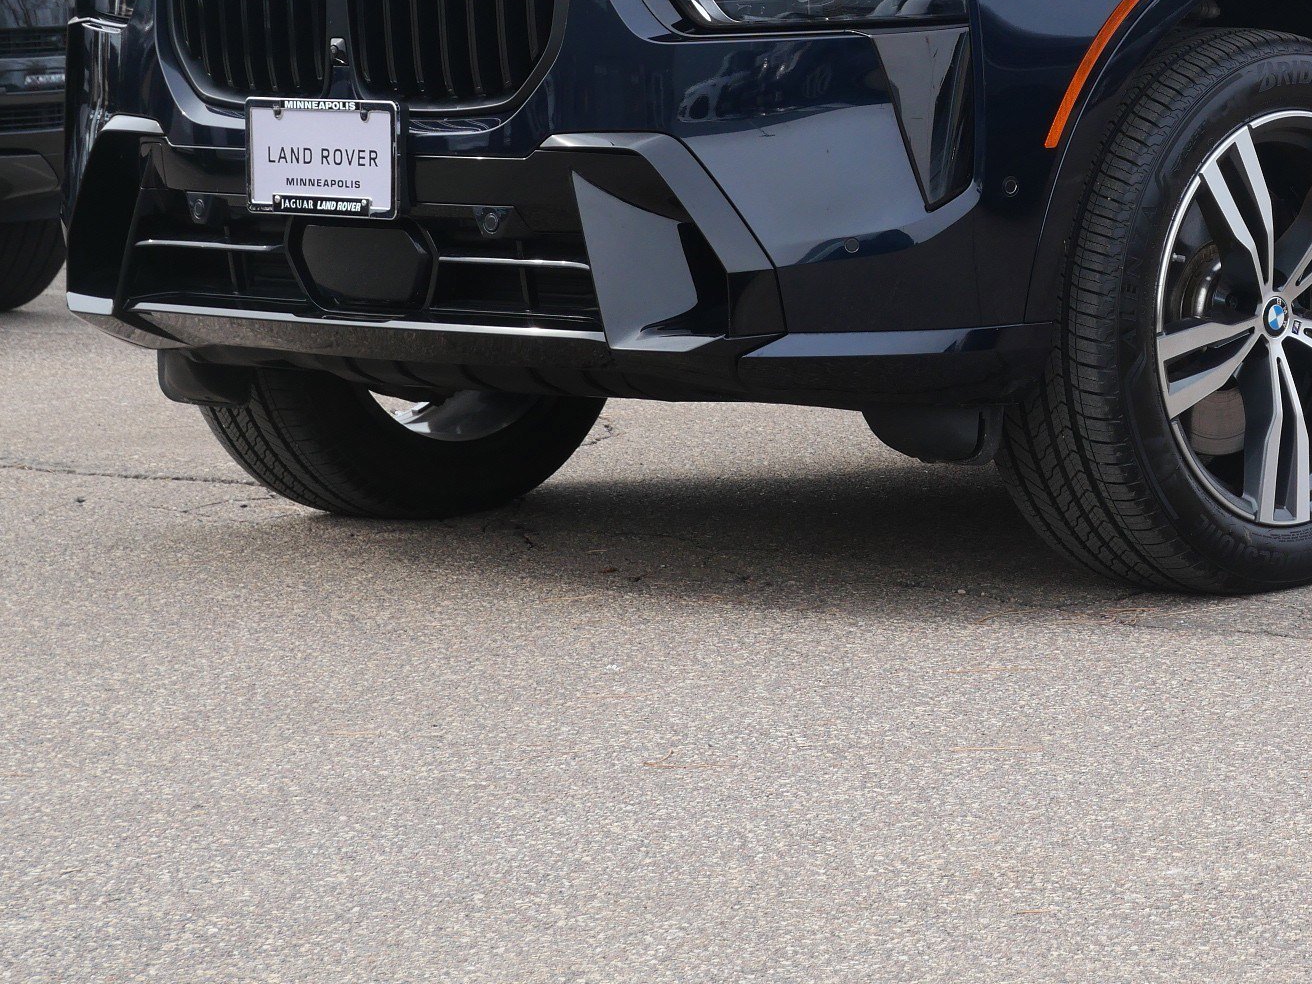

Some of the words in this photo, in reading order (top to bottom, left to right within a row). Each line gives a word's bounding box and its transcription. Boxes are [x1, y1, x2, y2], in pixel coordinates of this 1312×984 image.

[284, 100, 356, 111] MINNEAPOLIS
[267, 146, 313, 164] LAND
[321, 148, 379, 167] ROVER
[286, 177, 361, 189] MINNEAPOLIS
[281, 198, 314, 210] JAGUAR
[317, 200, 336, 211] LAND
[337, 201, 362, 212] ROVER
